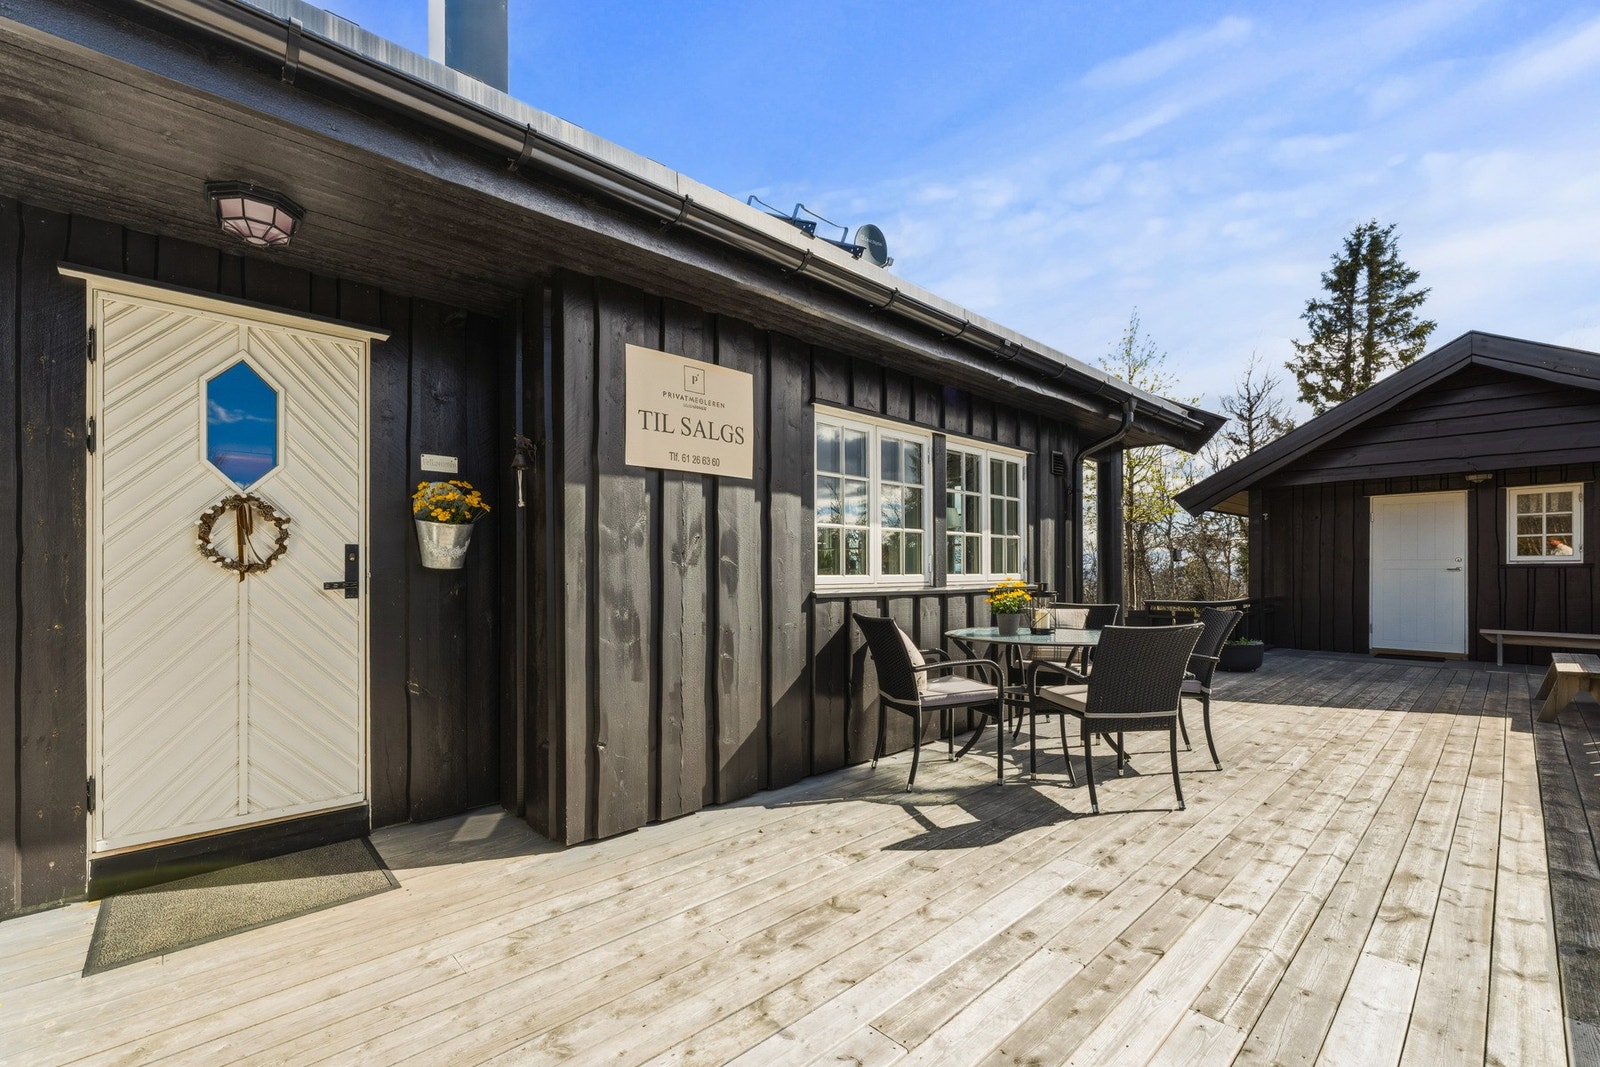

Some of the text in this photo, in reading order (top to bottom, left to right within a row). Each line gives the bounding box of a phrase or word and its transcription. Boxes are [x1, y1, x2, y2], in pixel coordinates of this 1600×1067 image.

[662, 390, 726, 409] PRIVATMEGLEREN
[637, 409, 745, 445] TIL SALGS
[668, 451, 721, 467] Tlf. 61 26 63 60
